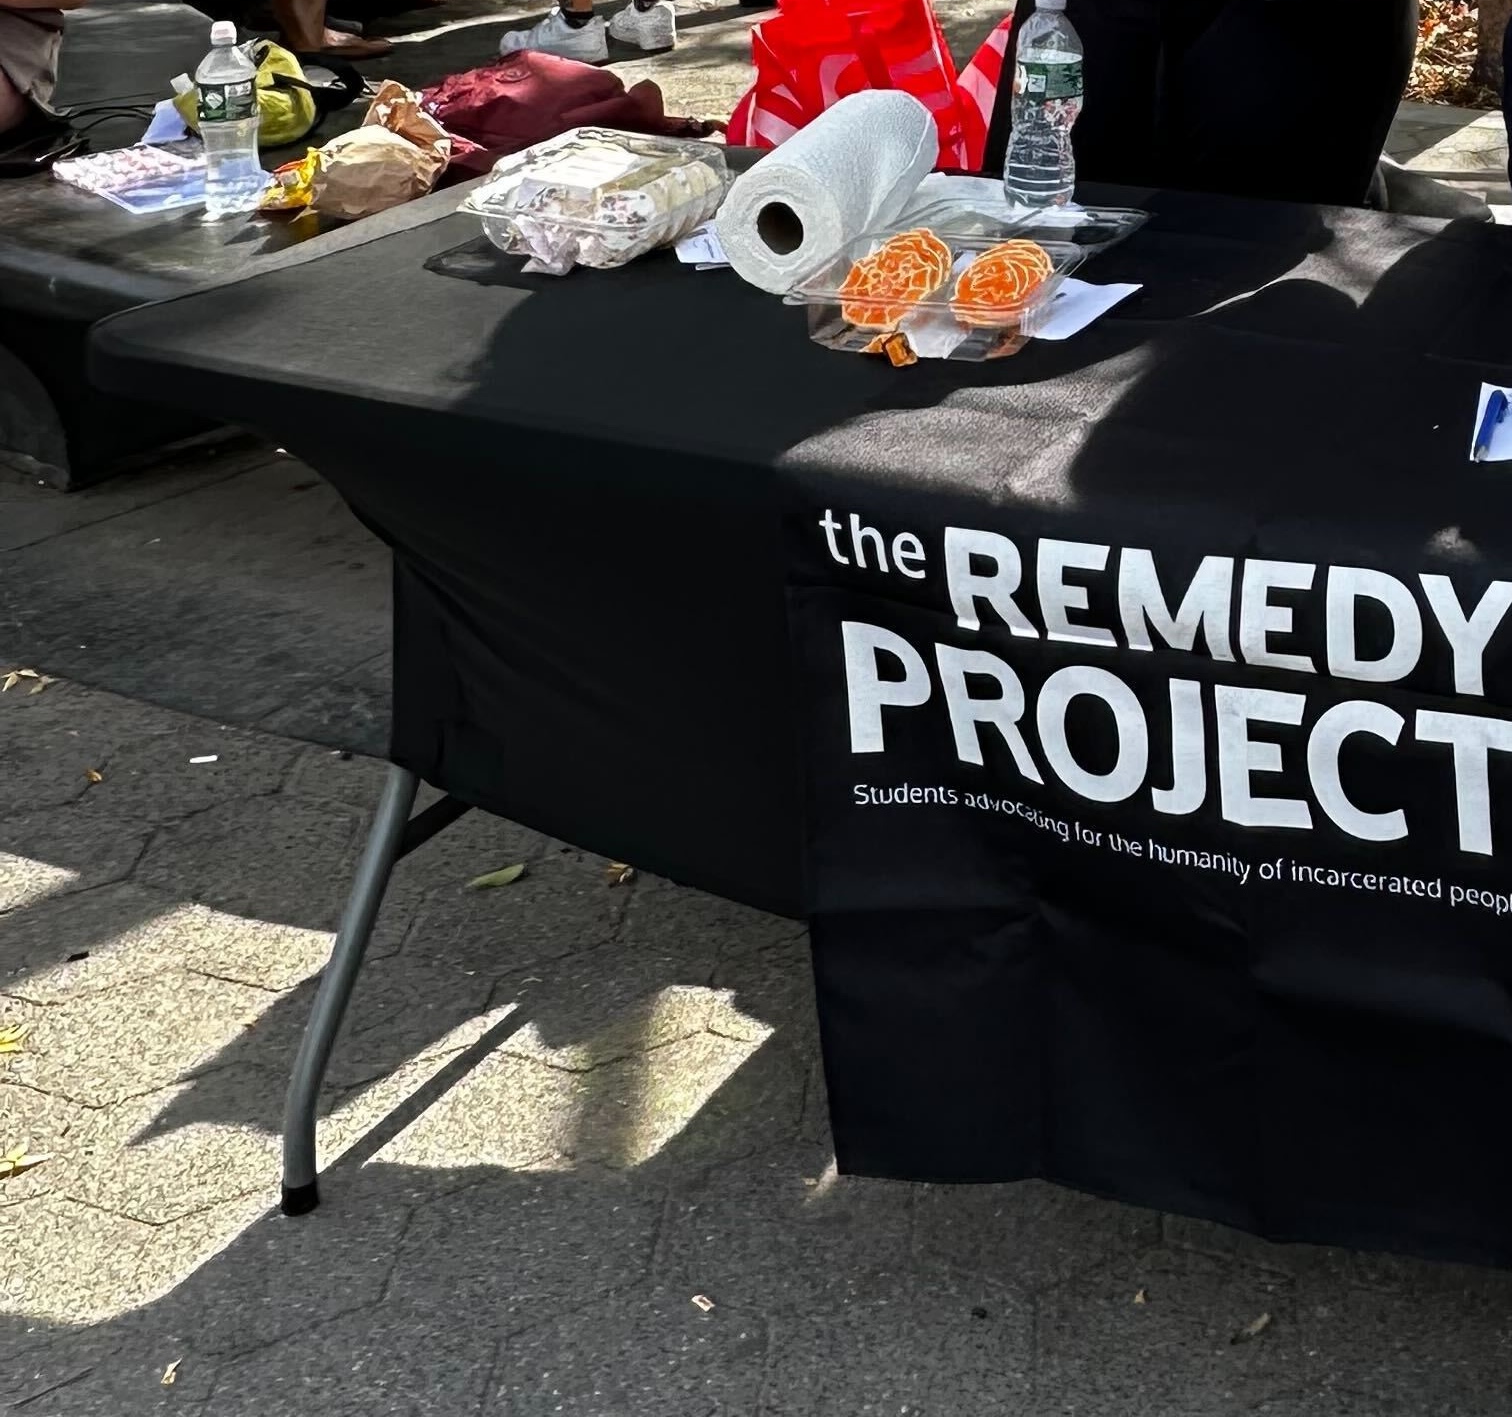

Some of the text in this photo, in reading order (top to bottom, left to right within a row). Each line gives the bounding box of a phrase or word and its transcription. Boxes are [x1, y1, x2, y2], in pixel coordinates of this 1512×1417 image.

[818, 508, 927, 580] the
[853, 782, 959, 806] Students
[964, 791, 1070, 843] advocating
[1074, 820, 1103, 847] for
[1108, 833, 1143, 858] the
[1148, 837, 1251, 885] humanity
[1258, 857, 1284, 880] of
[1291, 859, 1442, 899] incarcerated
